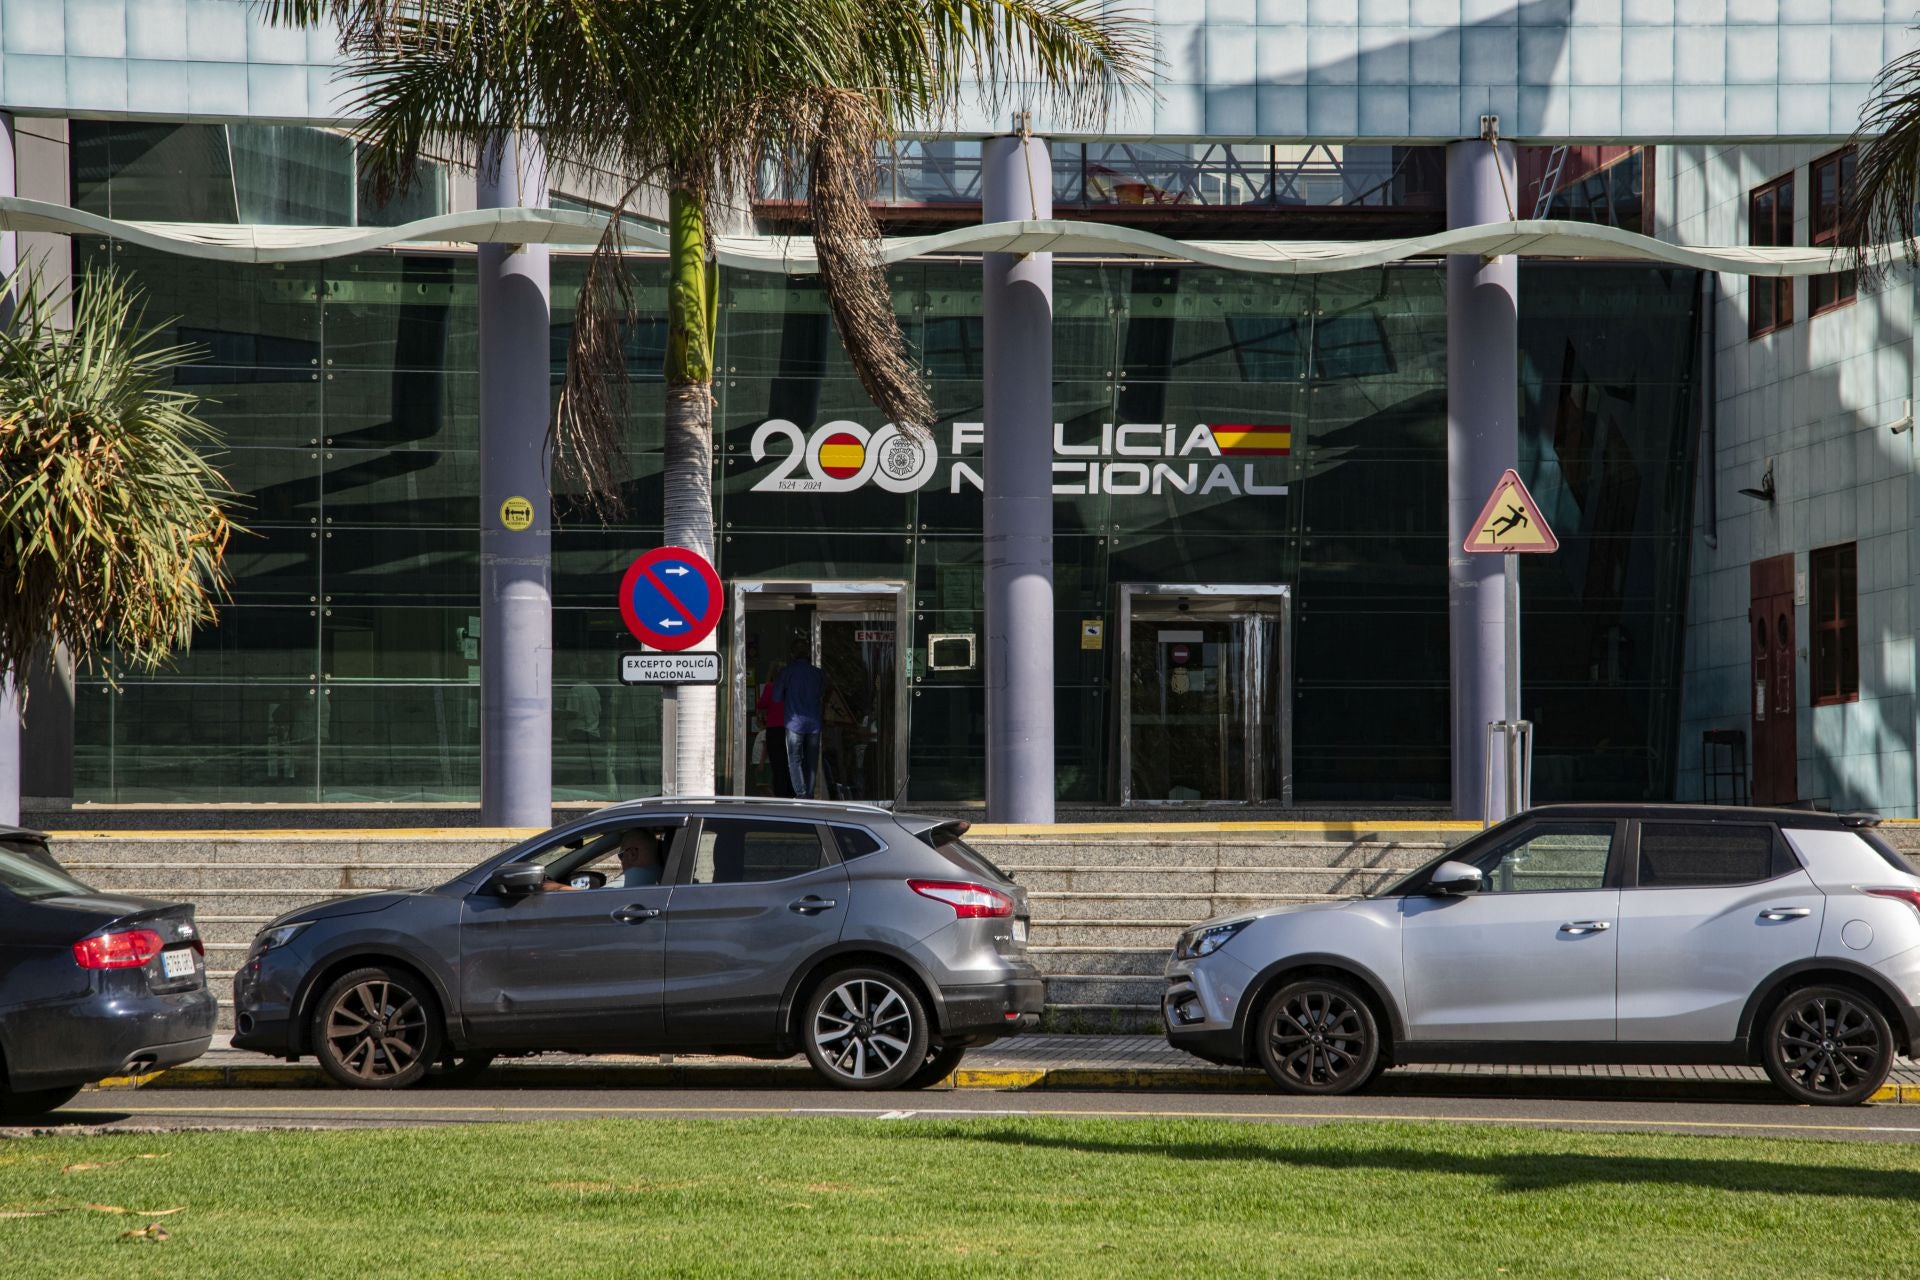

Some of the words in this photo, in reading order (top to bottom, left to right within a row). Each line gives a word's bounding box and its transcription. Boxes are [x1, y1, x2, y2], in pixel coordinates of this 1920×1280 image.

[952, 423, 1222, 457] PLICÍA
[751, 419, 938, 493] 200
[779, 481, 796, 490] 1824
[803, 481, 822, 490] 2024
[950, 461, 1289, 496] NCIONAL
[627, 660, 673, 668] EXCEPTO
[675, 657, 714, 668] POLICÍA
[645, 671, 696, 679] NACIONAL
